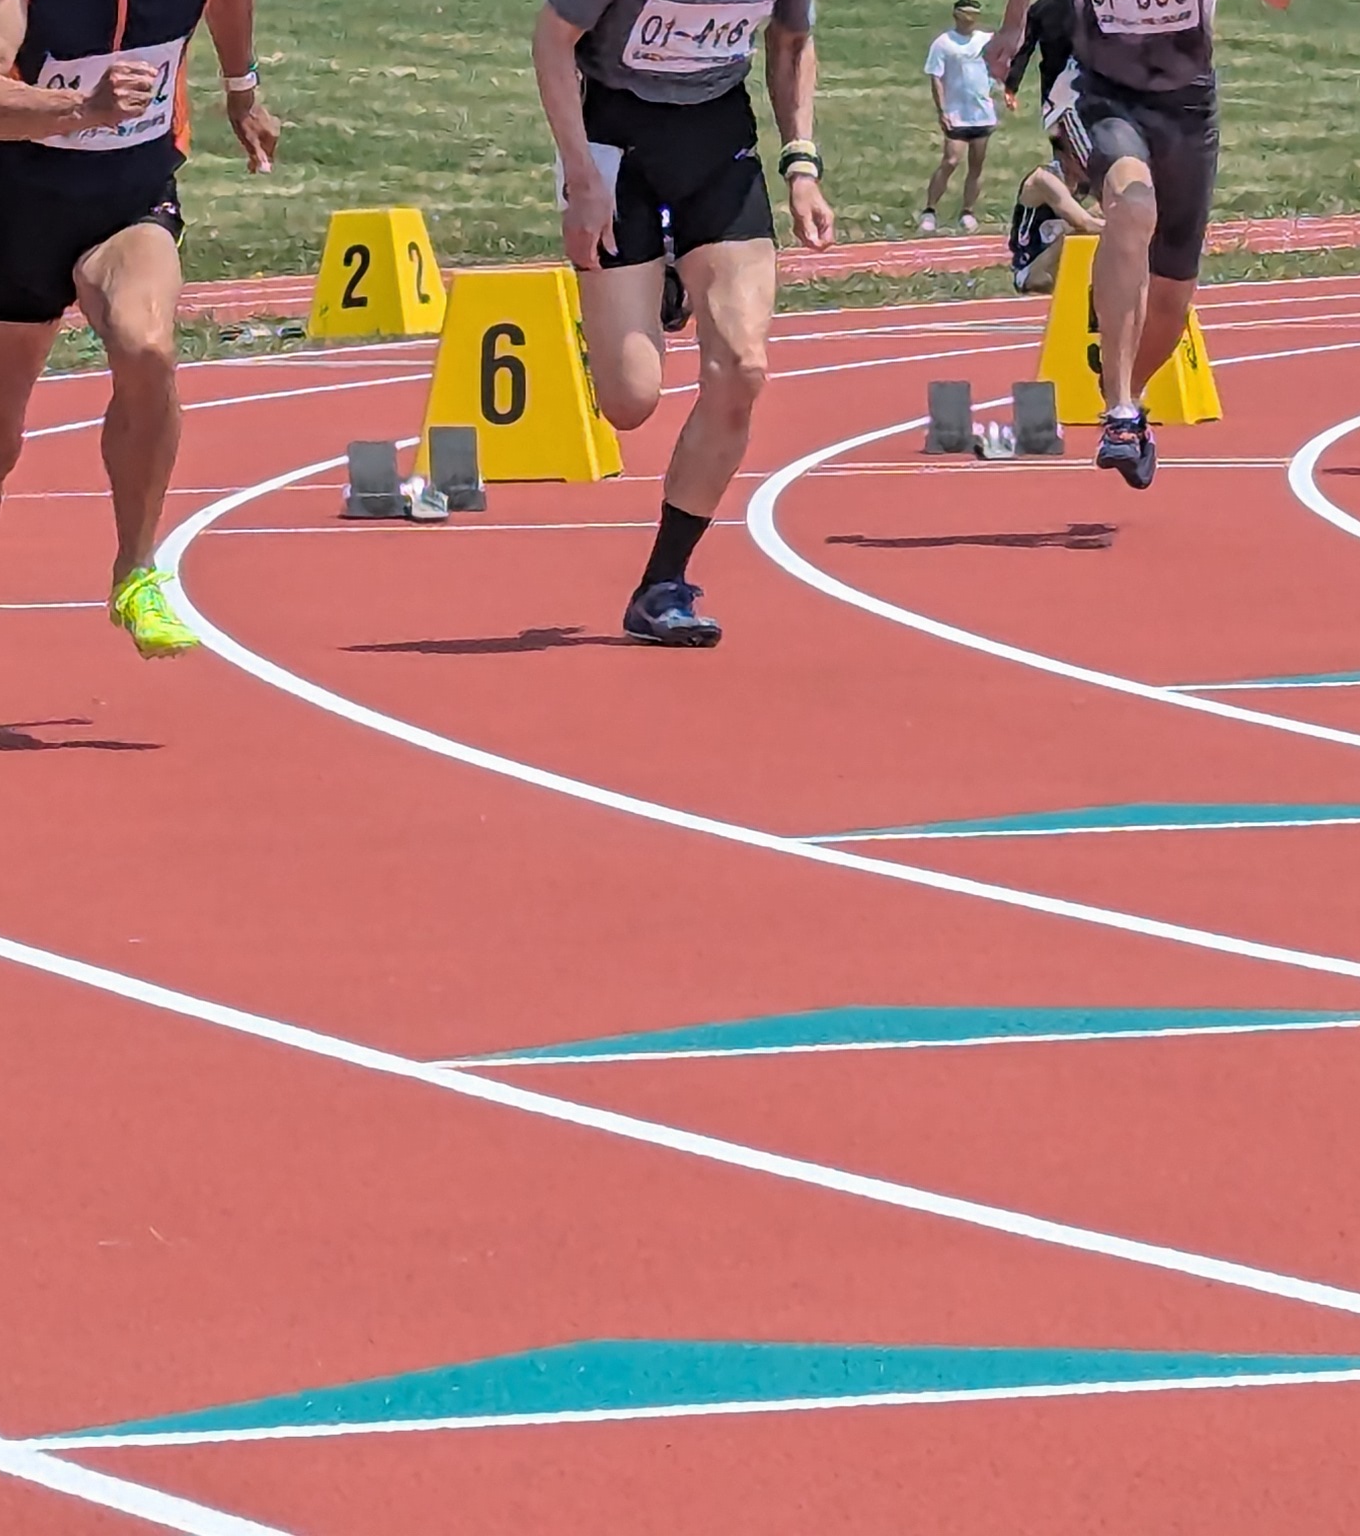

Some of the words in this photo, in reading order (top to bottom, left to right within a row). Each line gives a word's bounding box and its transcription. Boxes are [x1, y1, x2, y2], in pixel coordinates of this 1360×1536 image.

[341, 245, 370, 309] 2
[408, 241, 430, 304] 2
[480, 323, 526, 425] 6
